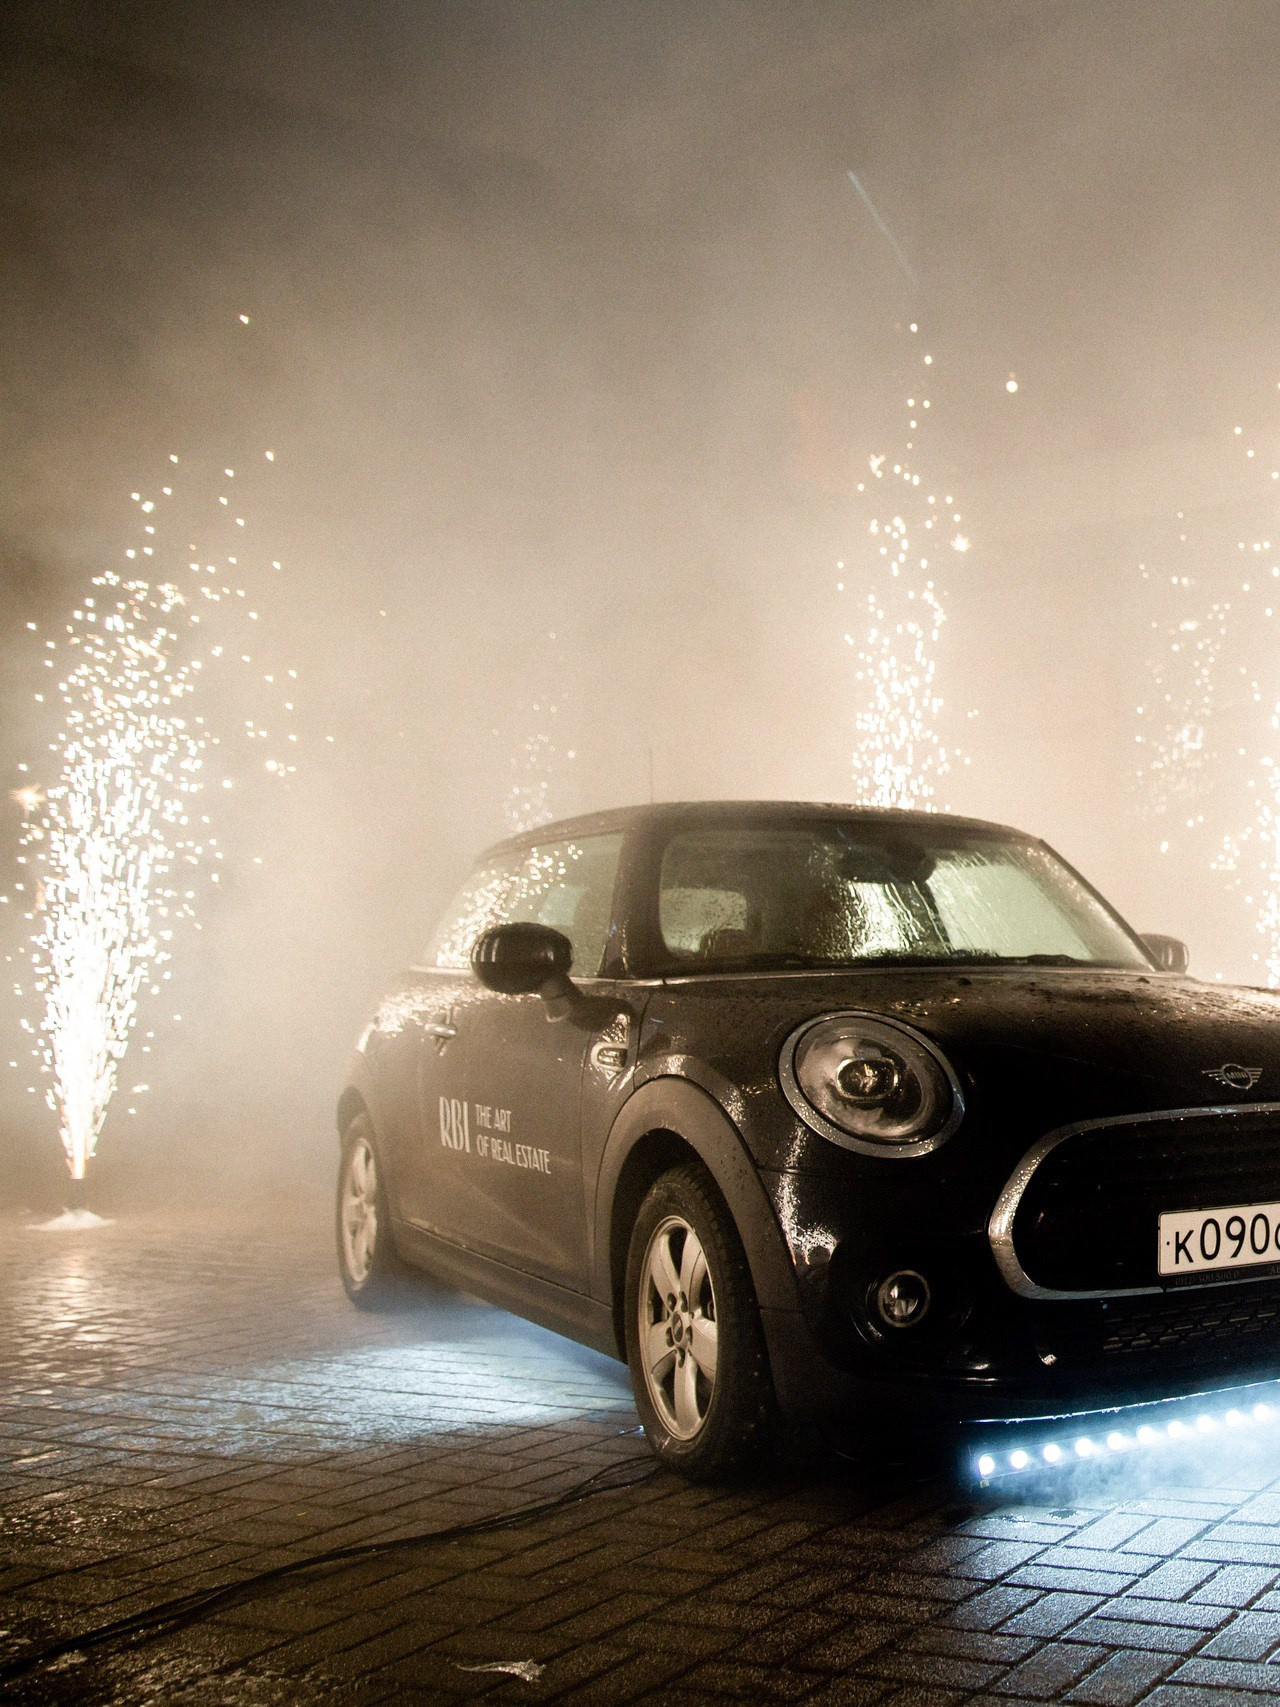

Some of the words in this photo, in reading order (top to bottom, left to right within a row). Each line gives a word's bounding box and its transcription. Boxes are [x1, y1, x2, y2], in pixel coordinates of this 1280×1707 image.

[438, 1096, 471, 1153] RBI
[474, 1103, 493, 1129] THE
[493, 1107, 512, 1133] ART
[476, 1133, 490, 1158] OF
[490, 1137, 516, 1165] REAL
[515, 1143, 552, 1175] ESTATE
